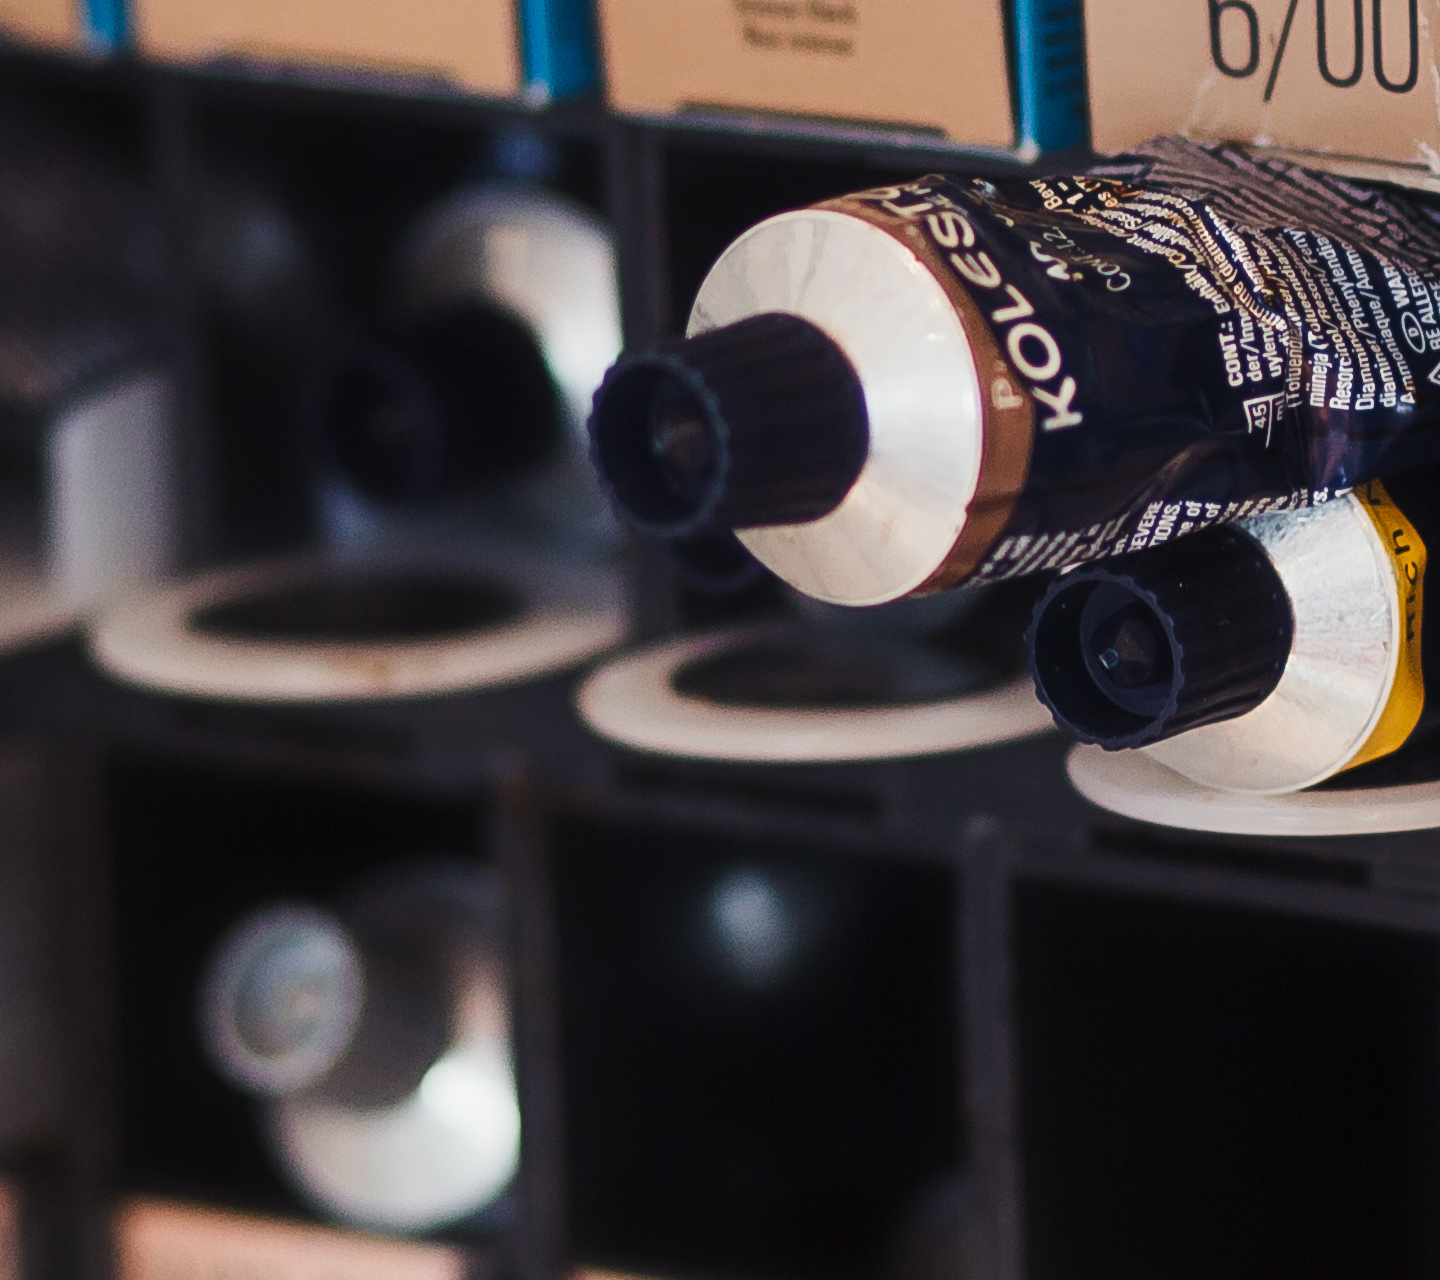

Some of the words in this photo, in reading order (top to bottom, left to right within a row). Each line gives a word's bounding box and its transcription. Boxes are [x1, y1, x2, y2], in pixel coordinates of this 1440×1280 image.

[858, 186, 1084, 433] KOLESTO
[1218, 320, 1244, 387] CONT.:
[1252, 403, 1267, 431] 45
